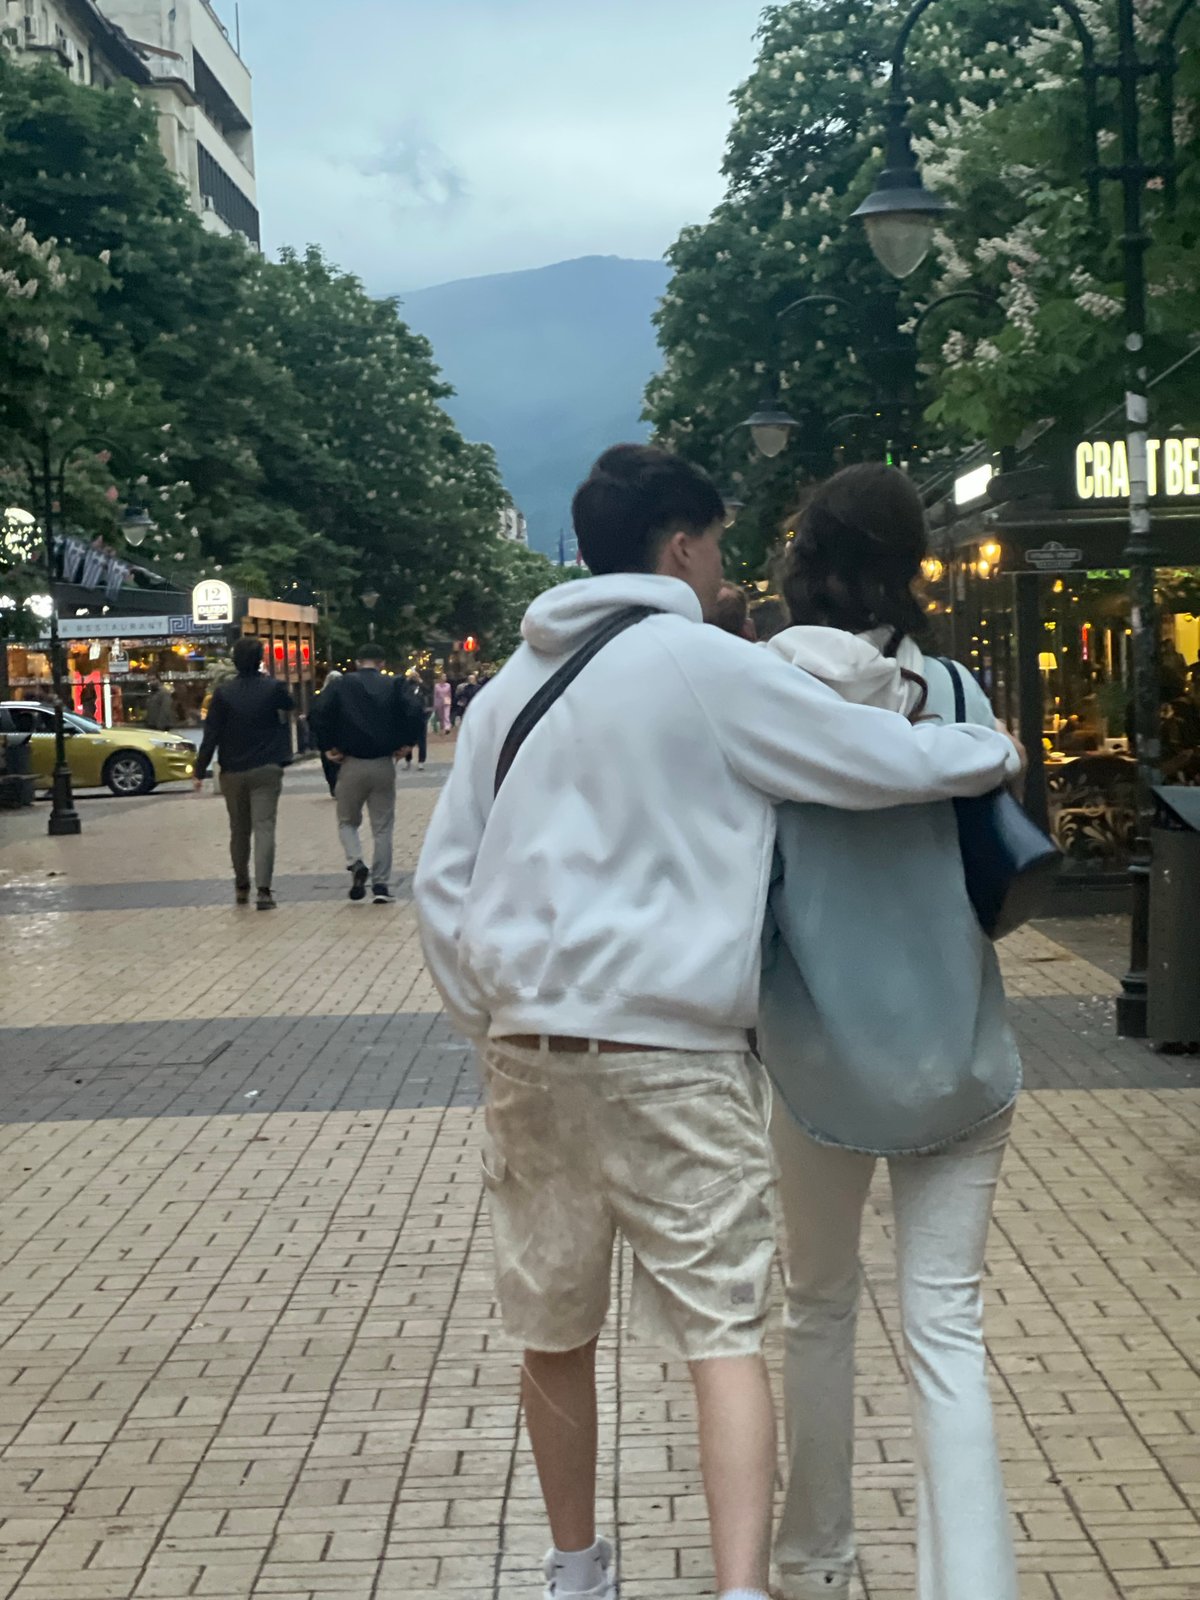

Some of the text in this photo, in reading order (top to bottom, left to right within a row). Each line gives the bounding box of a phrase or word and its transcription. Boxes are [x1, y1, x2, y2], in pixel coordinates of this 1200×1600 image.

[1076, 438, 1200, 499] CRAT BE
[205, 588, 221, 601] 12
[76, 621, 163, 633] RESTAURANT
